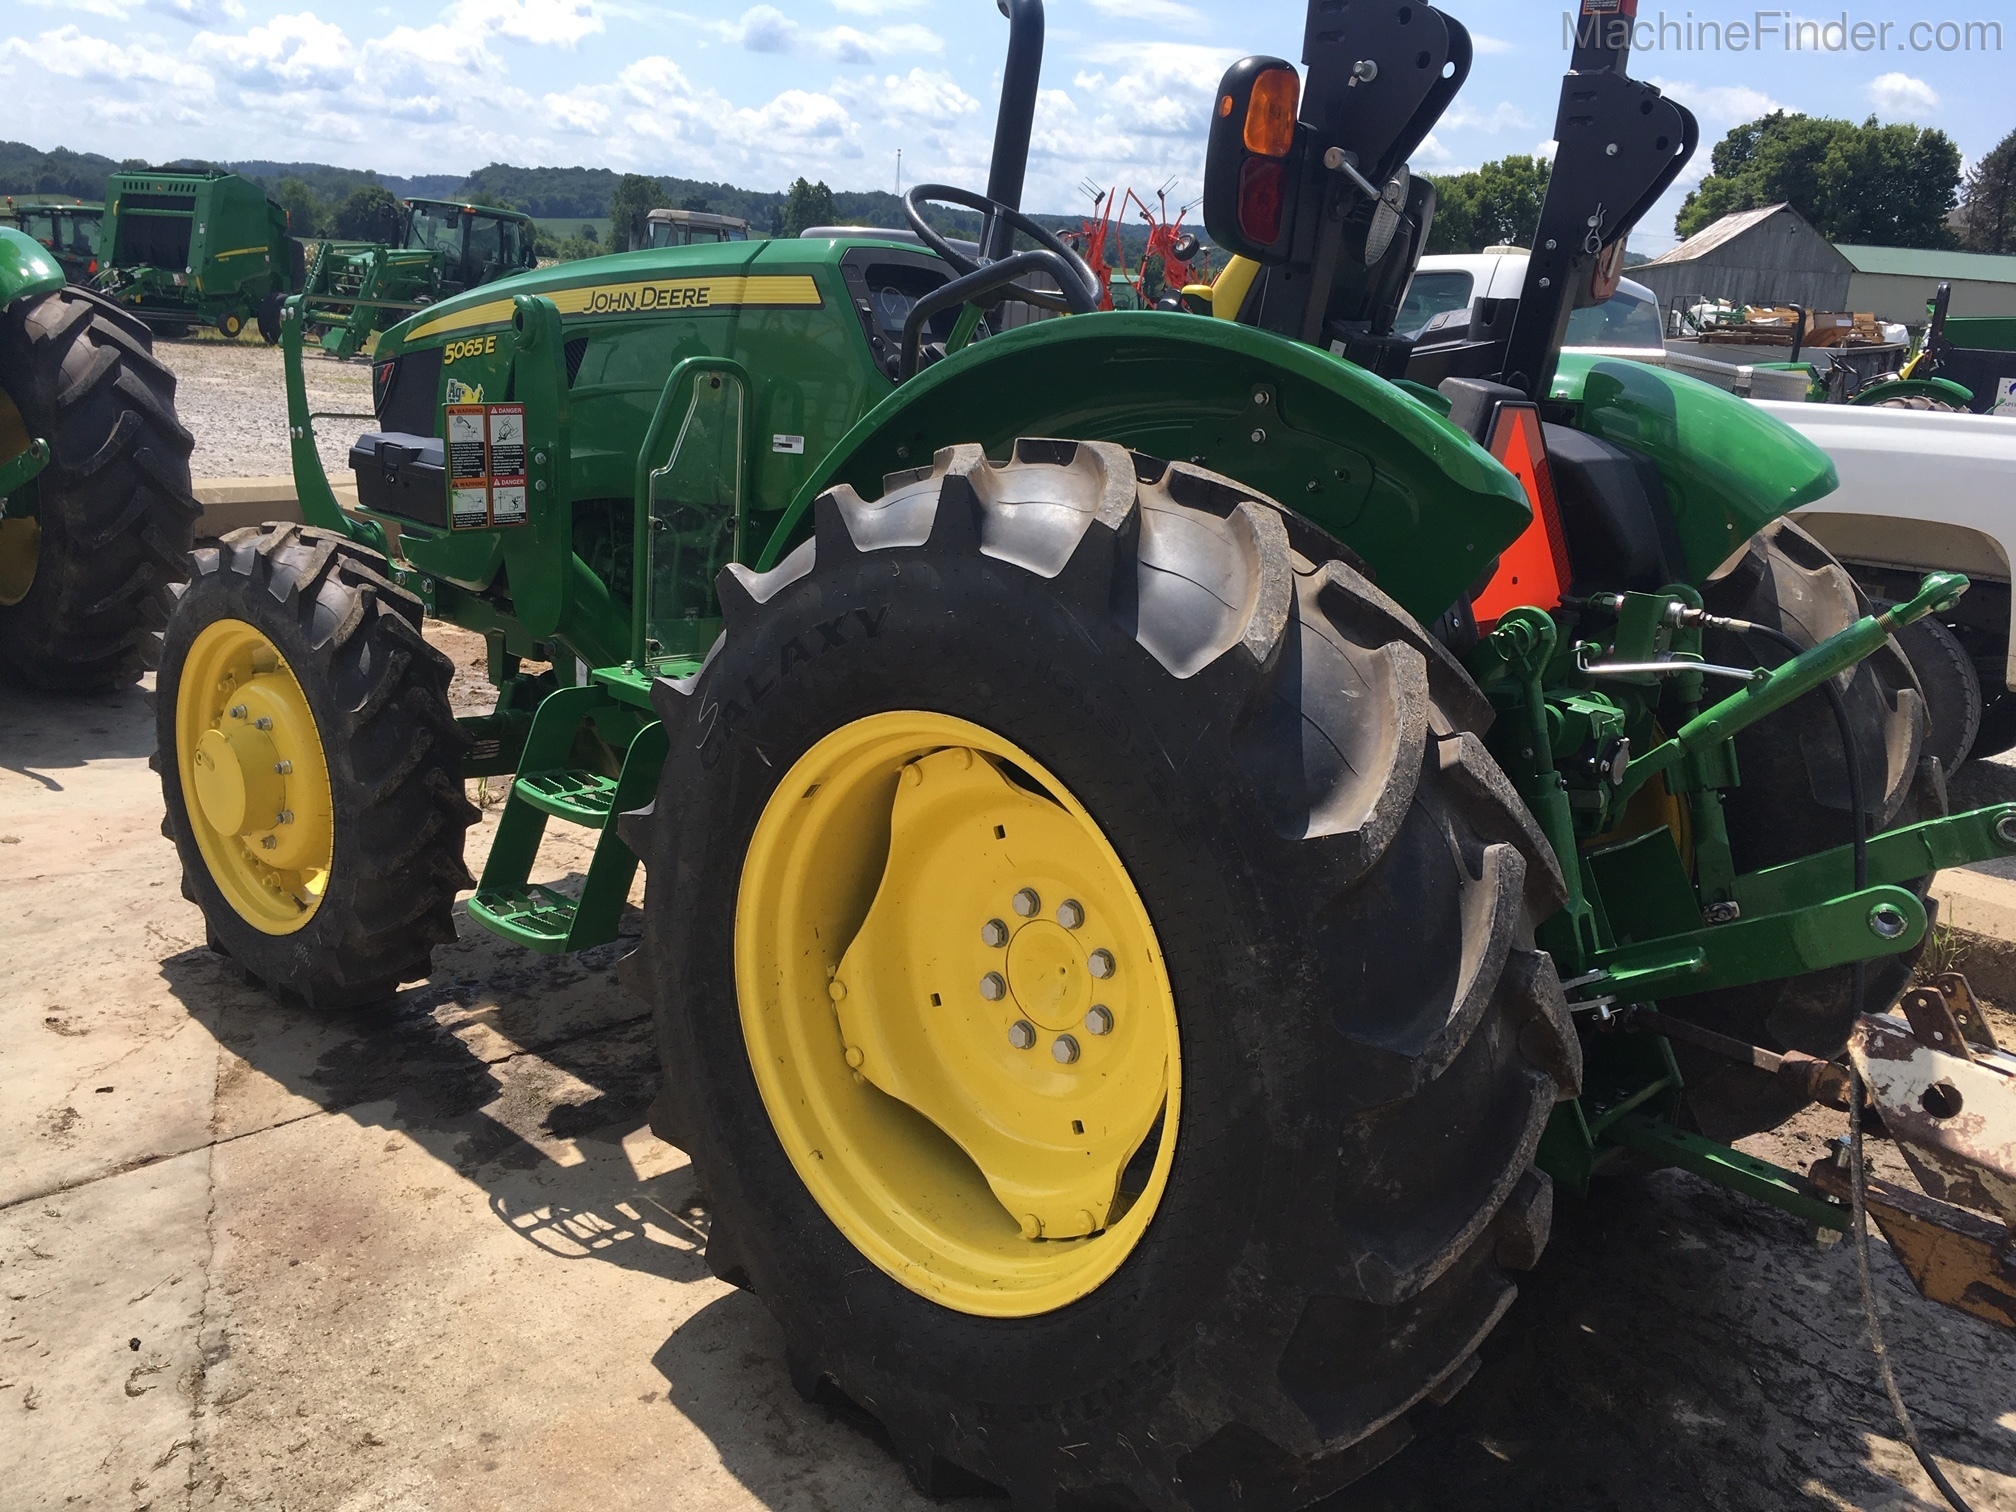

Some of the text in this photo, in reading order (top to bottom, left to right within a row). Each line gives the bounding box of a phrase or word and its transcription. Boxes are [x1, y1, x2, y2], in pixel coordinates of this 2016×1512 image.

[583, 286, 711, 313] JOHN DEERE
[700, 602, 893, 770] GALAXY
